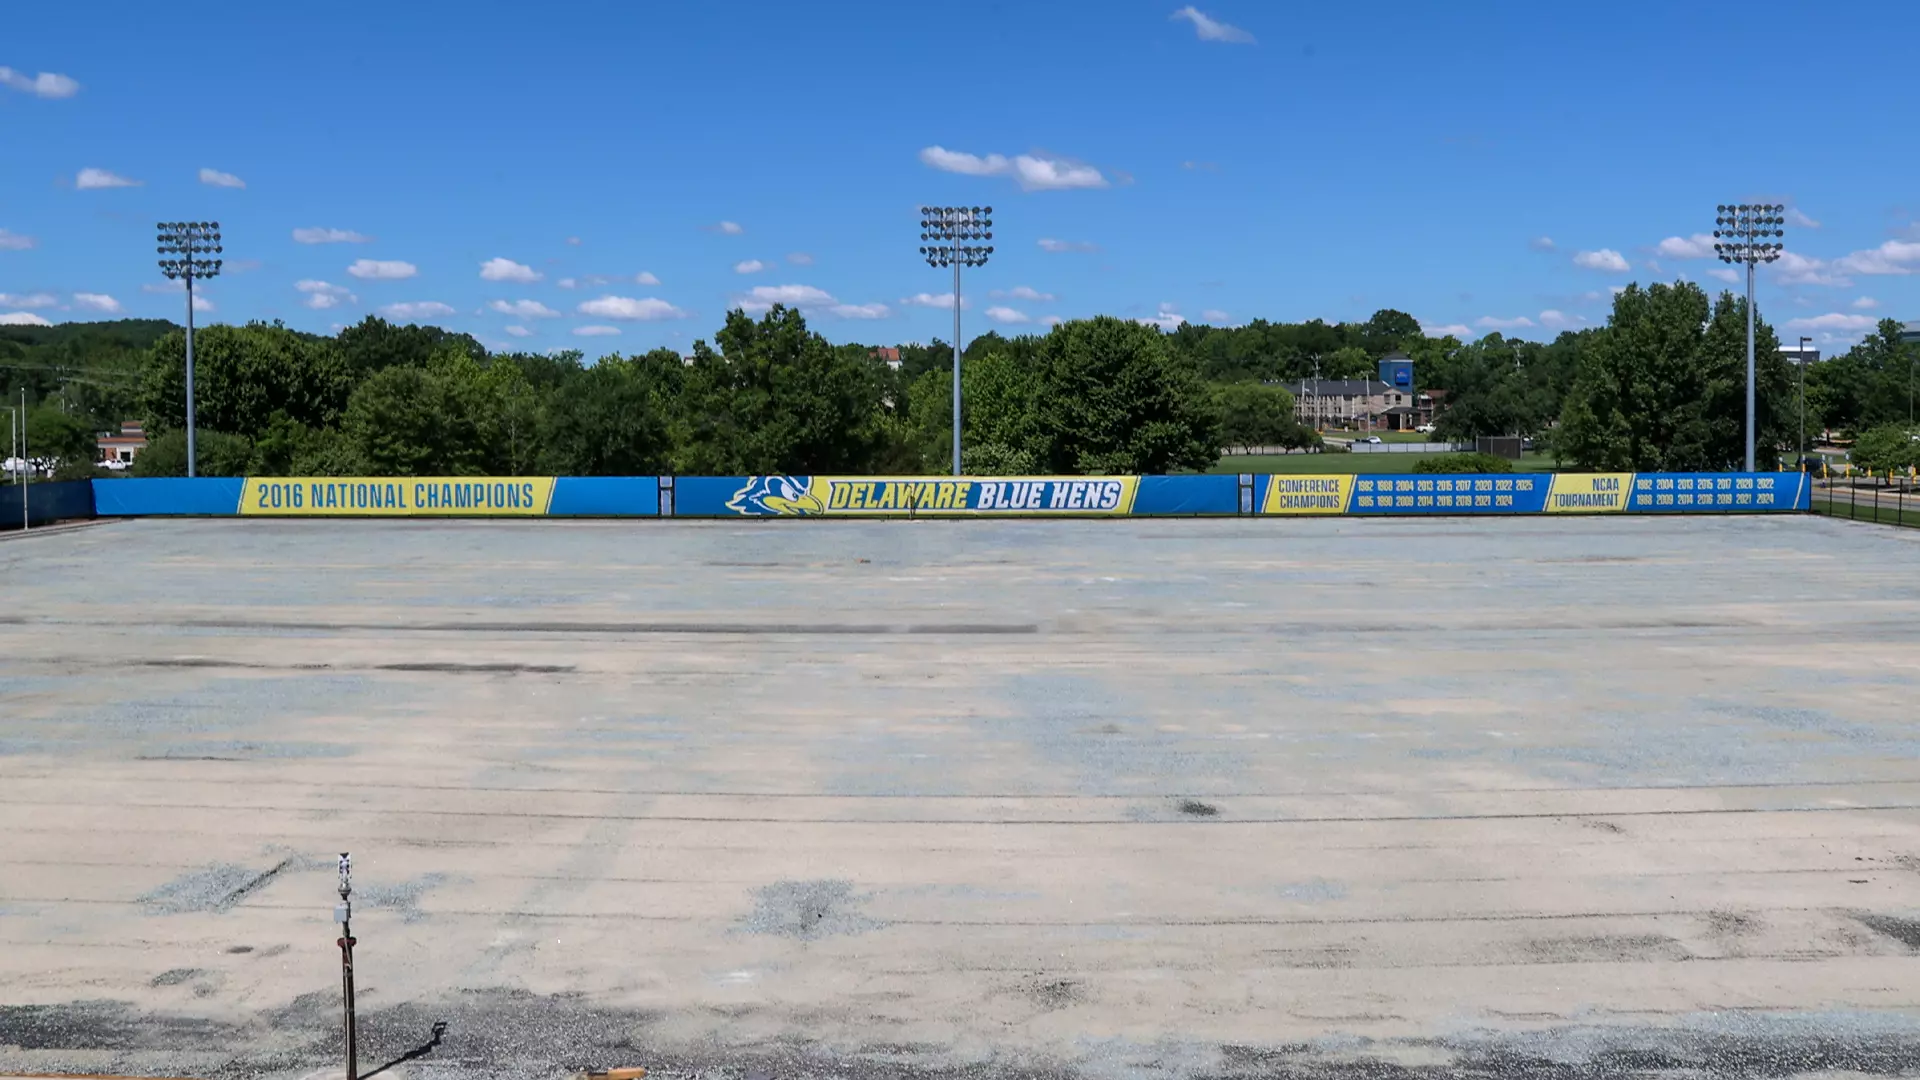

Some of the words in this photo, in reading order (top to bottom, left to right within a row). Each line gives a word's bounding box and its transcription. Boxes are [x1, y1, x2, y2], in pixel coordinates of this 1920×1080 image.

[1278, 479, 1340, 493] CONFERENCE
[1396, 479, 1414, 492] 2004
[1417, 479, 1434, 492] 2013
[1437, 479, 1453, 492] 2015
[1456, 479, 1471, 492] 2017
[1475, 479, 1493, 492] 2020
[1495, 479, 1513, 492] 2022
[1516, 479, 1533, 492] 2025
[1592, 478, 1619, 491] NCAA
[1656, 478, 1674, 491] 2004
[1677, 478, 1693, 491] 2013
[1698, 478, 1713, 491] 2015
[1717, 478, 1732, 491] 2017
[1736, 478, 1753, 491] 2020
[1757, 478, 1774, 491] 2022
[258, 483, 303, 508] 2016
[311, 483, 407, 508] NATIONAL
[414, 483, 533, 508] CHAMPIONS
[829, 482, 971, 509] DELAWARE
[977, 482, 1045, 509] BLUE
[1050, 482, 1120, 509] HENS
[1280, 495, 1340, 509] CHAMPIONS
[1396, 495, 1414, 507] 2009
[1417, 495, 1433, 507] 2014
[1437, 495, 1453, 507] 2016
[1456, 495, 1472, 507] 2019
[1475, 495, 1491, 507] 2021
[1495, 495, 1513, 507] 2024
[1554, 493, 1619, 507] TOURNAMENT
[1656, 493, 1674, 505] 2009
[1677, 493, 1693, 505] 2014
[1698, 493, 1713, 505] 2016
[1717, 493, 1732, 505] 2019
[1736, 493, 1752, 505] 2021
[1757, 493, 1774, 505] 2024
